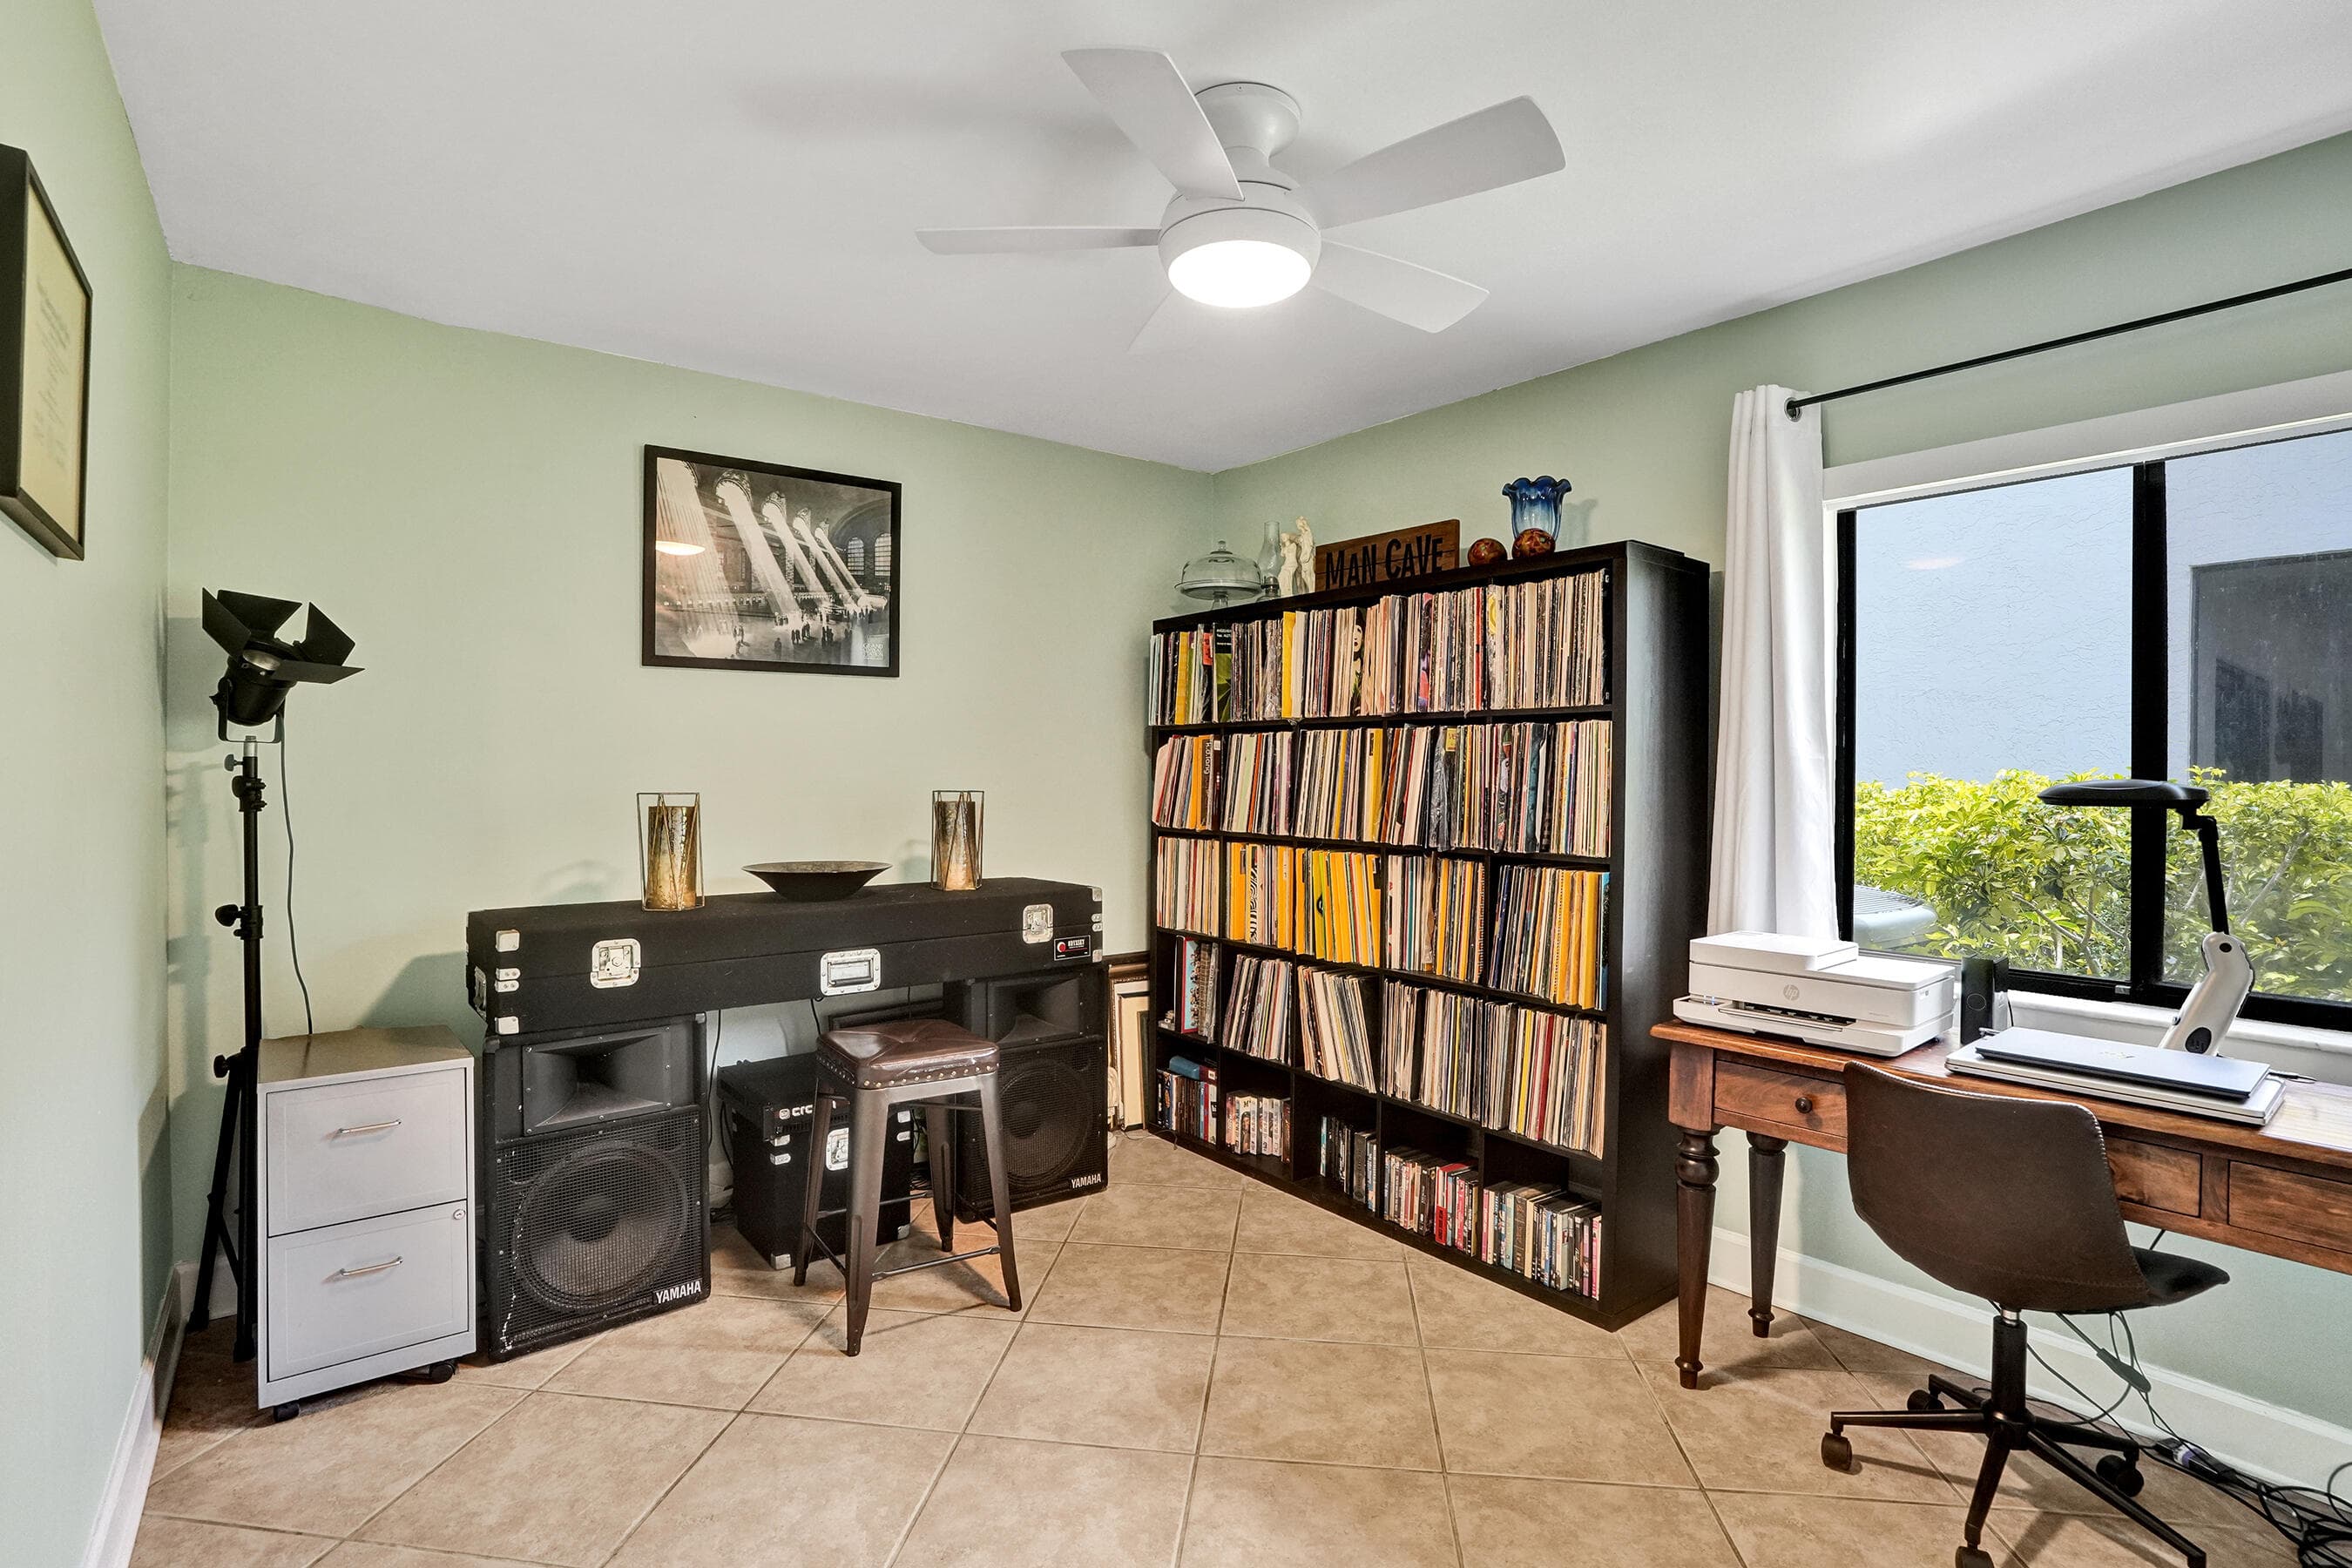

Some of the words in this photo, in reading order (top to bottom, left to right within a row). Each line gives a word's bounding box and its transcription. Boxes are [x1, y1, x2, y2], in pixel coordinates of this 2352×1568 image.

[1326, 544, 1376, 590] MAN
[1385, 534, 1443, 578] CAVE
[1071, 1173, 1102, 1189] YAMAHA
[656, 1280, 702, 1304] YAMAHA
